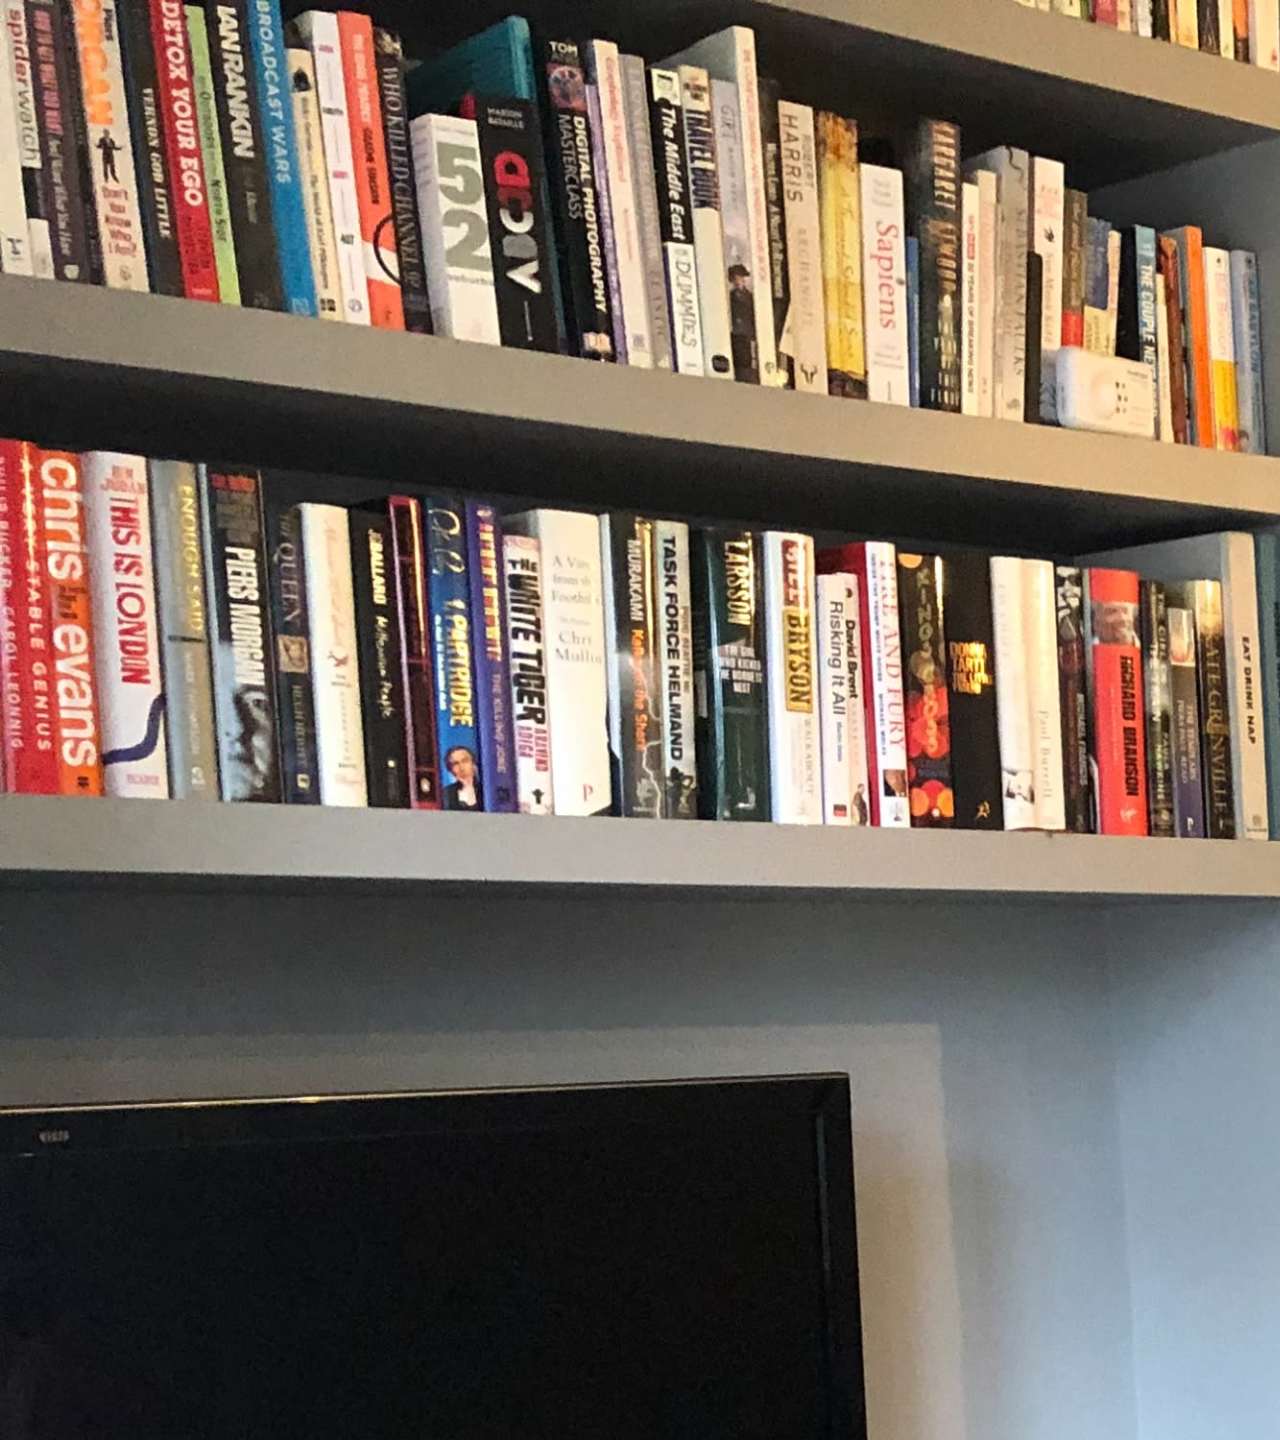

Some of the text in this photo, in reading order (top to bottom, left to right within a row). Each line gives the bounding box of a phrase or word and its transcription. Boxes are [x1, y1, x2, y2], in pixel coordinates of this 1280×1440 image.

[7, 9, 39, 161] spiderwatch
[75, 0, 113, 124] ORGAN
[216, 5, 255, 158] IAN RANKIN
[255, 0, 292, 185] BROADCAST WARS
[550, 41, 578, 55] TOM
[160, 0, 204, 207] DETOX YOUR EGO
[142, 87, 159, 148] VERNON
[155, 187, 172, 239] LITTLE
[379, 66, 419, 263] WHO KILLED CHANNEL
[557, 113, 582, 220] MASTERCLASS
[660, 106, 689, 239] The Middle East
[780, 112, 803, 203] HARRIS
[572, 115, 607, 313] DIGITAL PHOTOGRAPHY
[674, 256, 699, 345] DUMMIES
[869, 221, 898, 333] Sapiens
[1139, 262, 1158, 364] THE COUPLE NE
[40, 457, 85, 581] chris
[109, 497, 142, 547] THIS
[112, 552, 146, 577] IS
[180, 484, 204, 633] ENOUGH SAID
[25, 558, 48, 650] STABLE
[223, 546, 259, 600] PIERS
[274, 541, 302, 625] QUEEN
[369, 541, 389, 606] BALLARD
[626, 539, 645, 623] MURAKAMI
[723, 539, 755, 627] LARSSON
[115, 581, 152, 687] LONDON
[229, 602, 266, 687] MORGAN
[441, 613, 474, 729] PARTRIDGE
[506, 573, 547, 726] WHITE TIGER
[662, 535, 686, 763] TASK FORCE HELMAND
[786, 612, 811, 706] BRYSON
[826, 599, 847, 716] Risking It All
[844, 618, 859, 660] David
[845, 659, 860, 700] Brent
[882, 623, 903, 680] AND
[6, 671, 24, 749] LEONNIG
[31, 661, 52, 751] GENIUS
[52, 621, 98, 767] evans
[517, 725, 534, 758] ADIGA
[884, 685, 906, 752] FURY
[1118, 654, 1140, 797] RICHARD BRANSON
[1241, 636, 1258, 746] EAT DRINK NAP
[1039, 748, 1055, 800] Burrell
[1206, 690, 1230, 817] GRENVILLE
